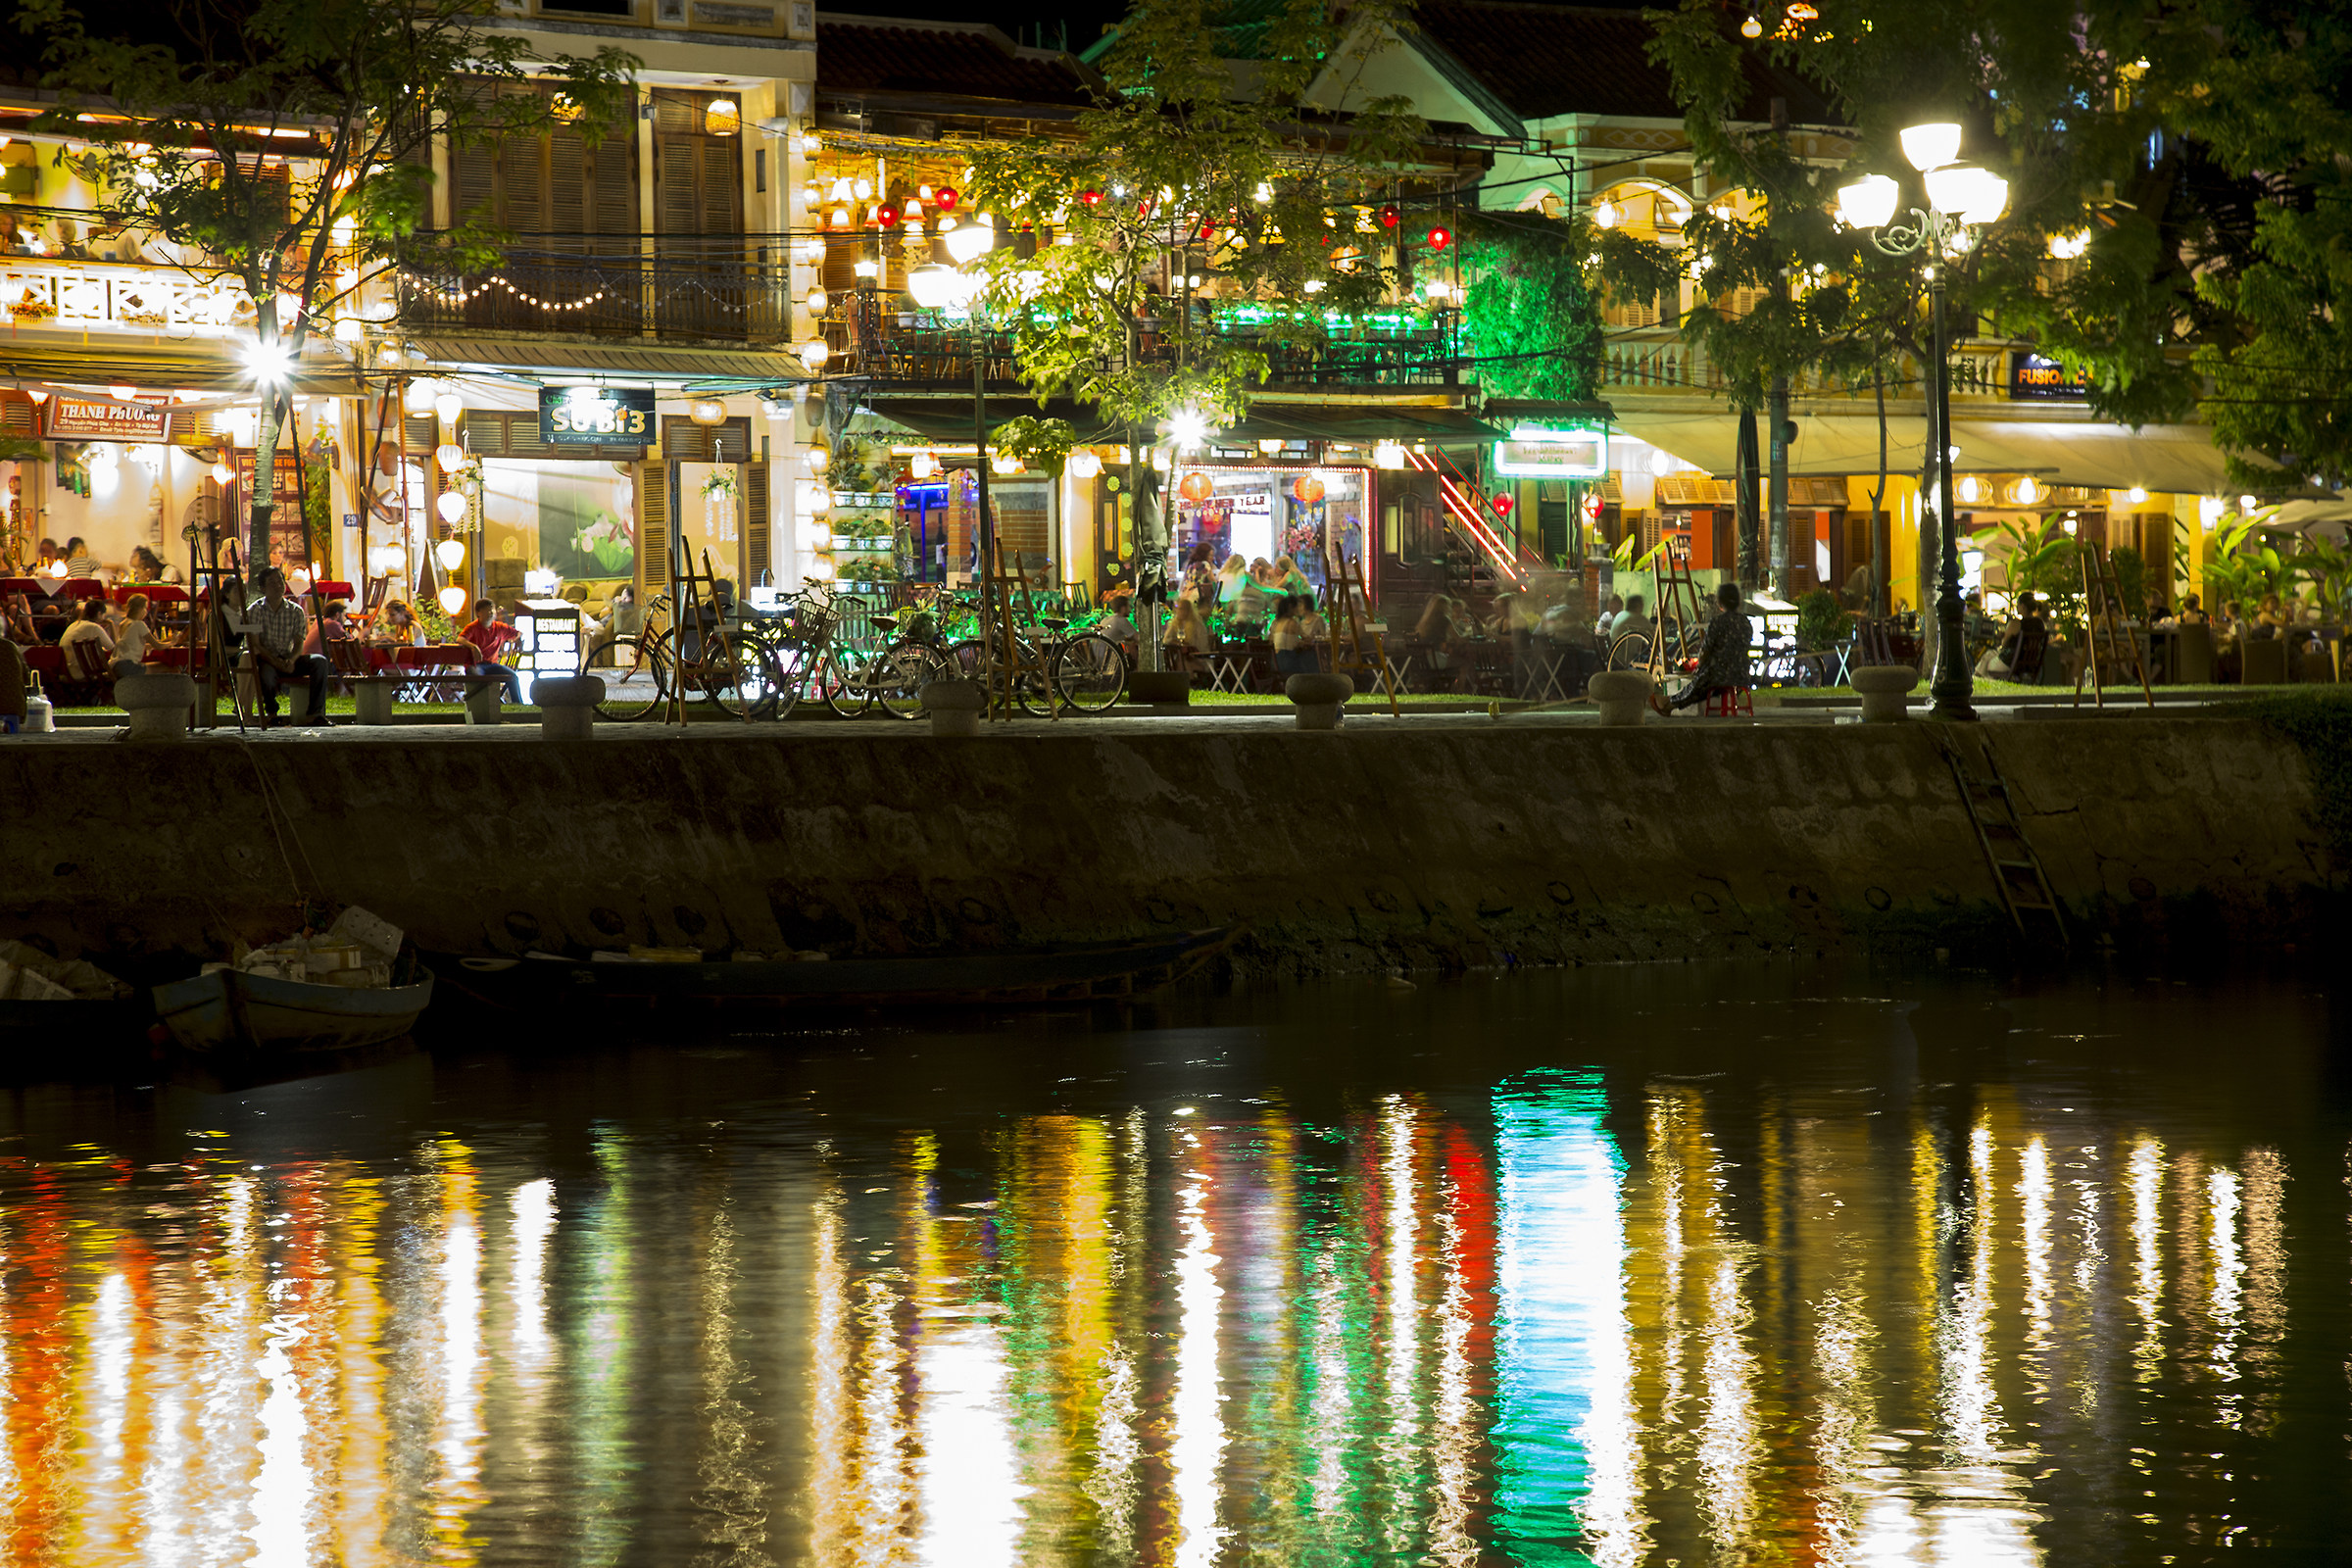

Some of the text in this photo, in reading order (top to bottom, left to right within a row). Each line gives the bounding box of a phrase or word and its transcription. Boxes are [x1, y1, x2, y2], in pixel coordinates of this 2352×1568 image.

[60, 404, 106, 419] THANH
[1240, 496, 1264, 506] YEAR
[346, 515, 357, 524] 29
